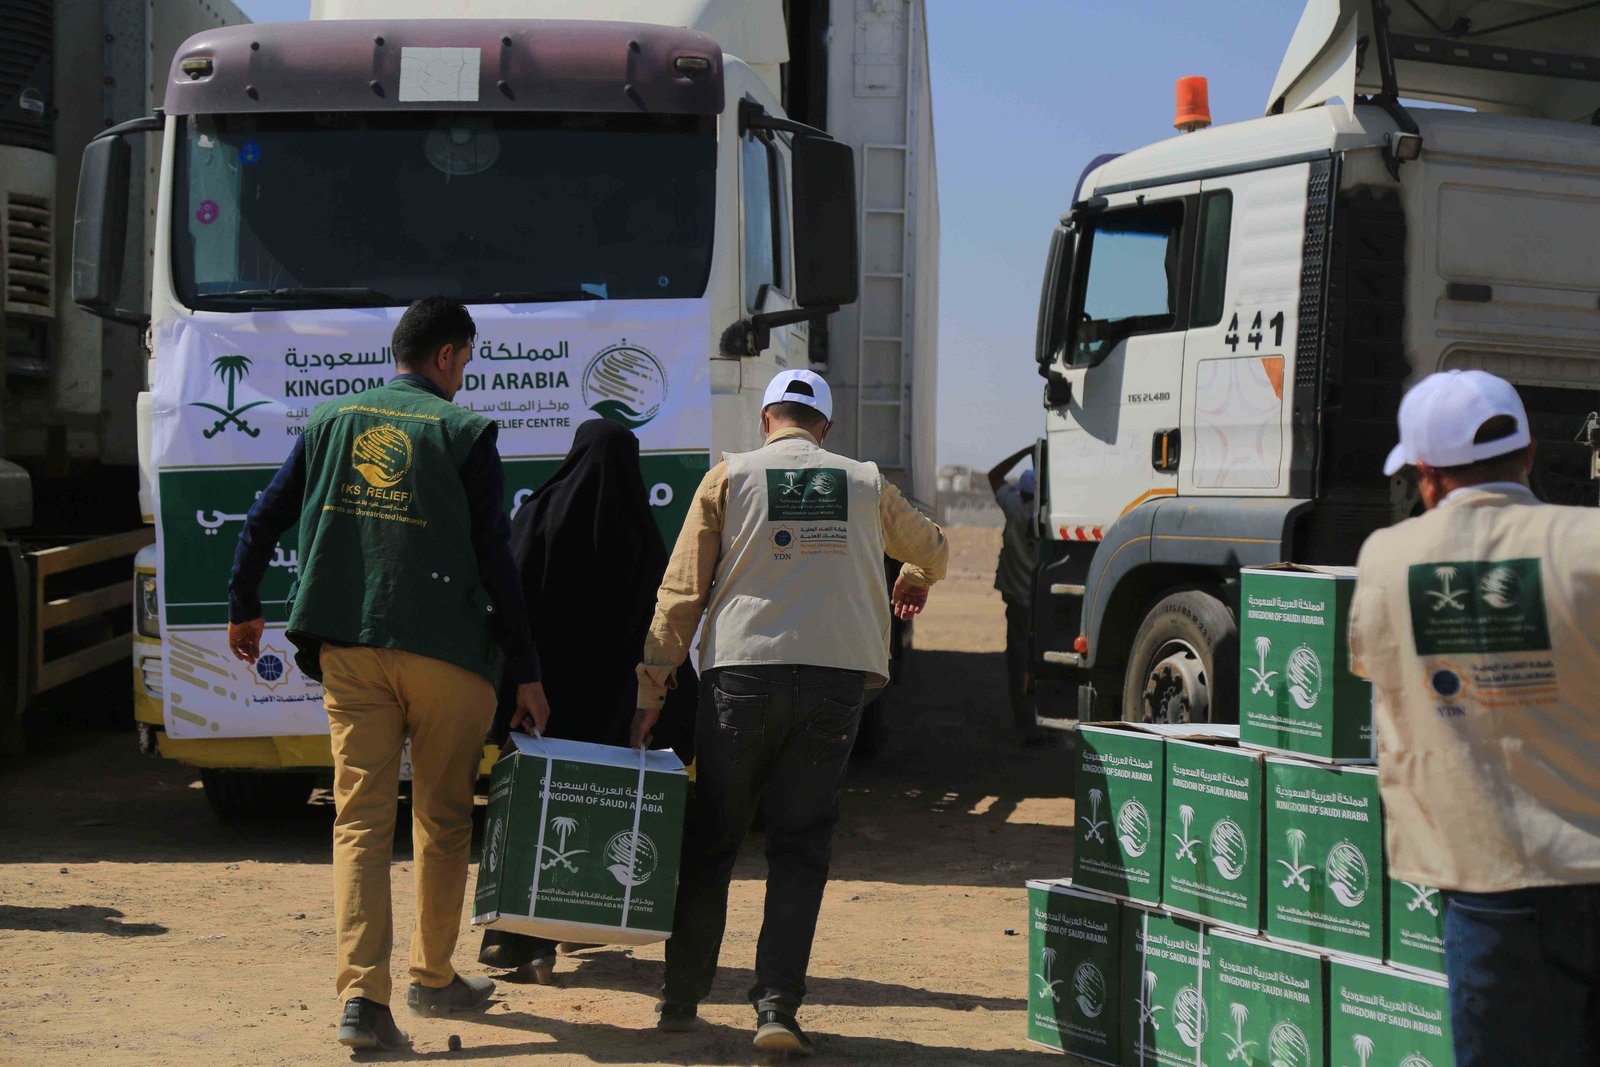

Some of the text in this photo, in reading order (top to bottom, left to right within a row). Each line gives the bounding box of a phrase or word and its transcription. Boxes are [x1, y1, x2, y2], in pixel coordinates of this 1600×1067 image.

[1224, 310, 1284, 352] 441
[284, 340, 569, 374] المملكة السعودية
[491, 371, 570, 390] ARABIA
[526, 417, 570, 428] CENTRE
[1247, 609, 1325, 625] KINGDOM OF SAUDI ARABIA
[1106, 767, 1114, 776] OF
[1113, 767, 1131, 779] SAUDI
[1131, 771, 1153, 782] ARABIA
[589, 782, 624, 796] العربية
[1172, 777, 1249, 801] KINGDOM OF SAUDI ARABIA
[1311, 789, 1337, 804] العربية
[585, 796, 599, 805] OF
[599, 797, 628, 809] SAUDI
[1337, 792, 1368, 807] المملكة
[1275, 800, 1369, 822] KINGDOM OF SAUDI ARABIA
[1068, 928, 1086, 940] SAUDI
[1085, 932, 1108, 944] ARABIA
[1160, 950, 1169, 959] OF
[1169, 951, 1188, 963] SAUDI
[1253, 966, 1279, 982] العربية
[1279, 972, 1310, 989] المملكة
[1219, 973, 1311, 1004] KINGDOM OF SAUDI ARABIA
[1379, 995, 1407, 1012] العربية
[1407, 1001, 1442, 1021] المملكة
[1341, 1003, 1443, 1037] KINGDOM OF SAUDI ARABIA
